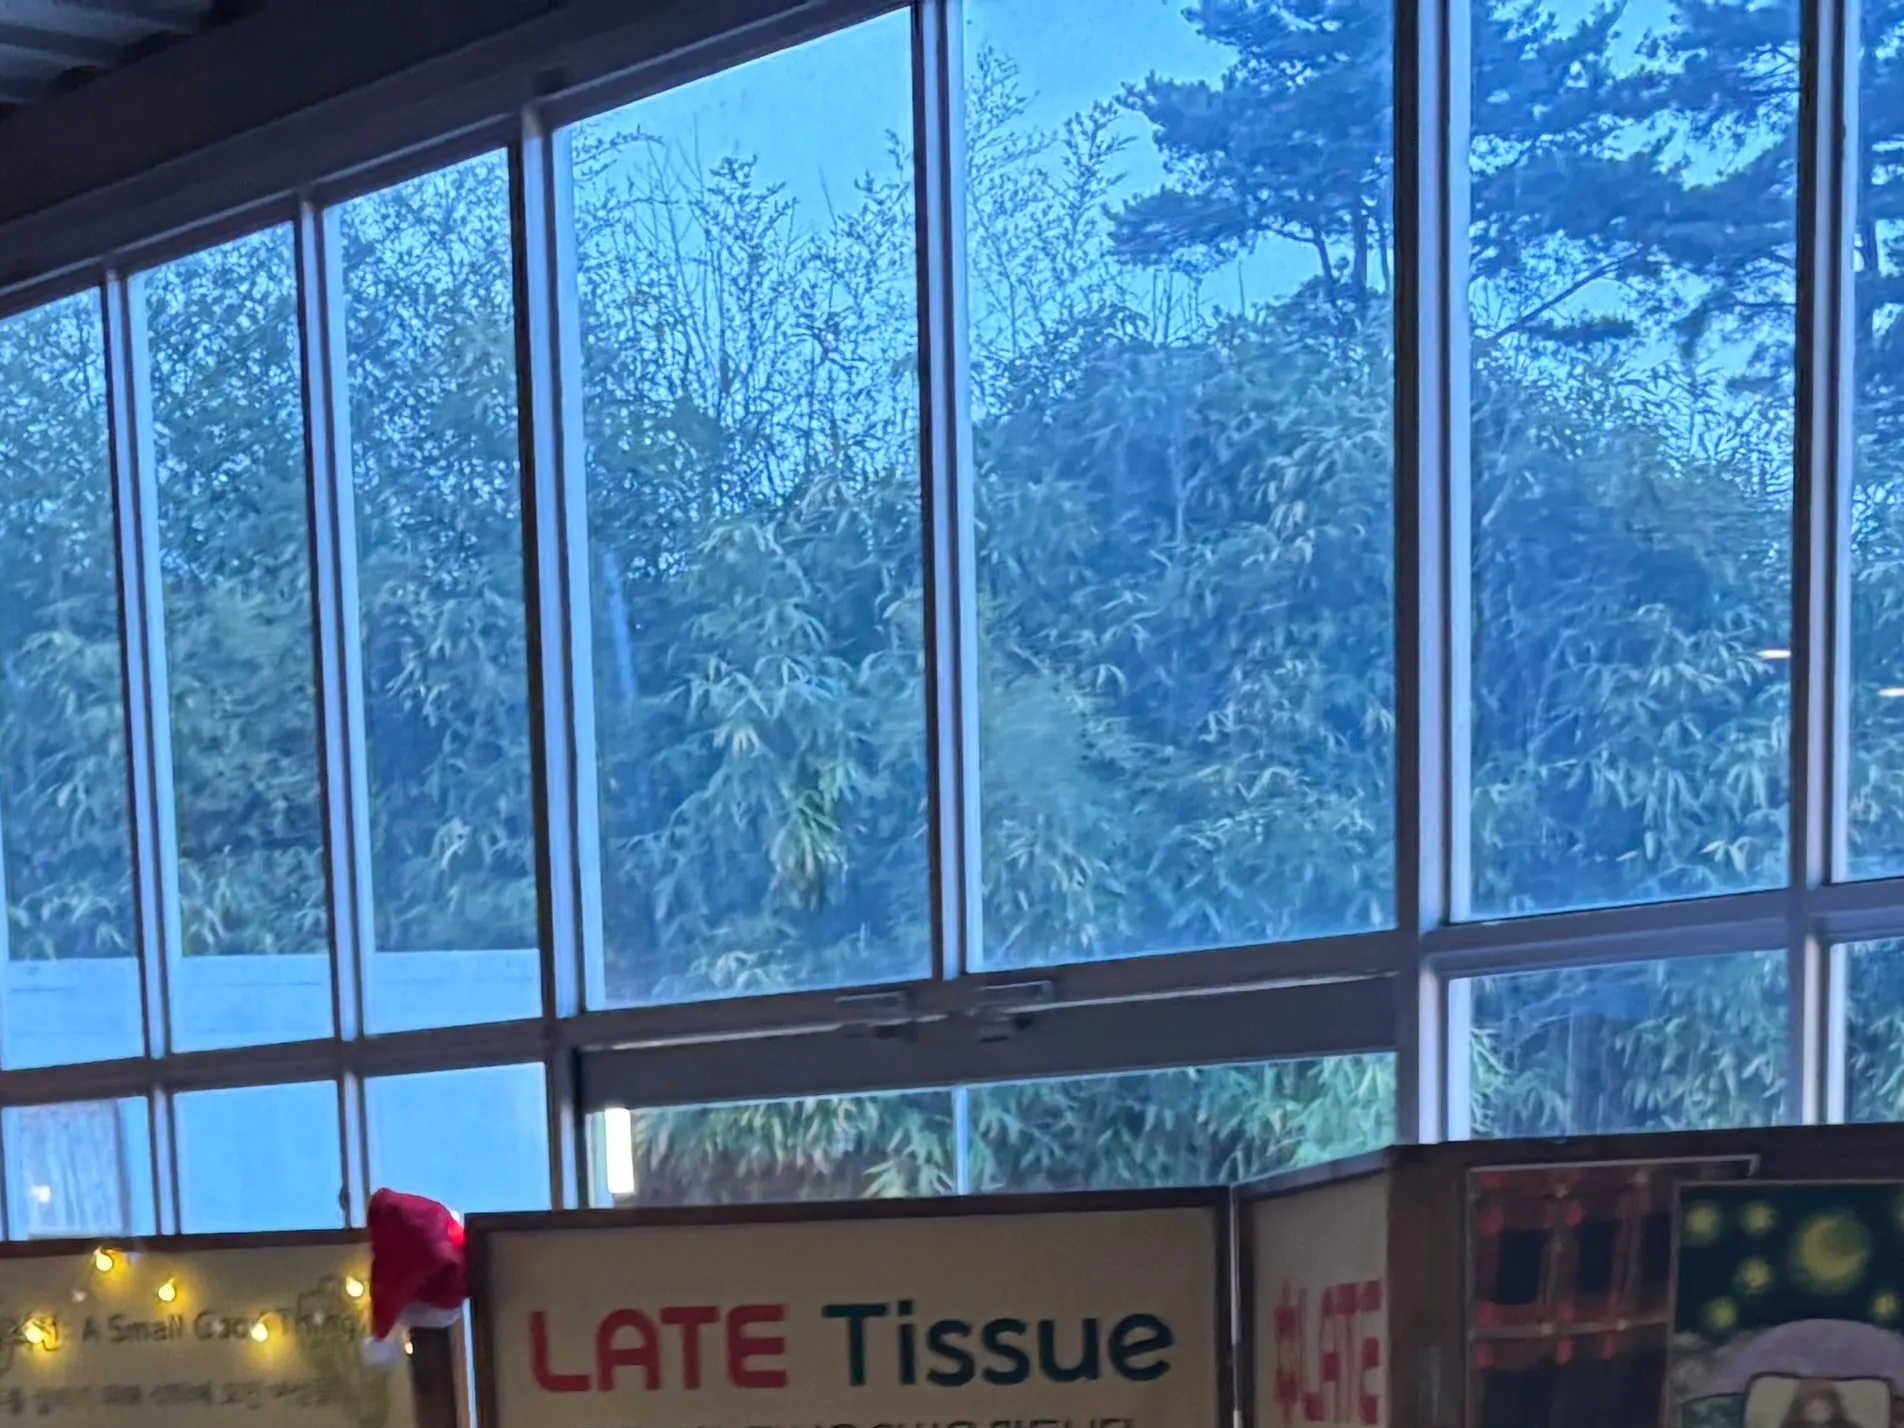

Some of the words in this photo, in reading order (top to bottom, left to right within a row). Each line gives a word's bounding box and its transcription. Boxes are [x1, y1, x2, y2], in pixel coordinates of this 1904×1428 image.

[106, 1312, 184, 1344] Small
[527, 1303, 789, 1394] LATE
[821, 1299, 1175, 1387] Tissue
